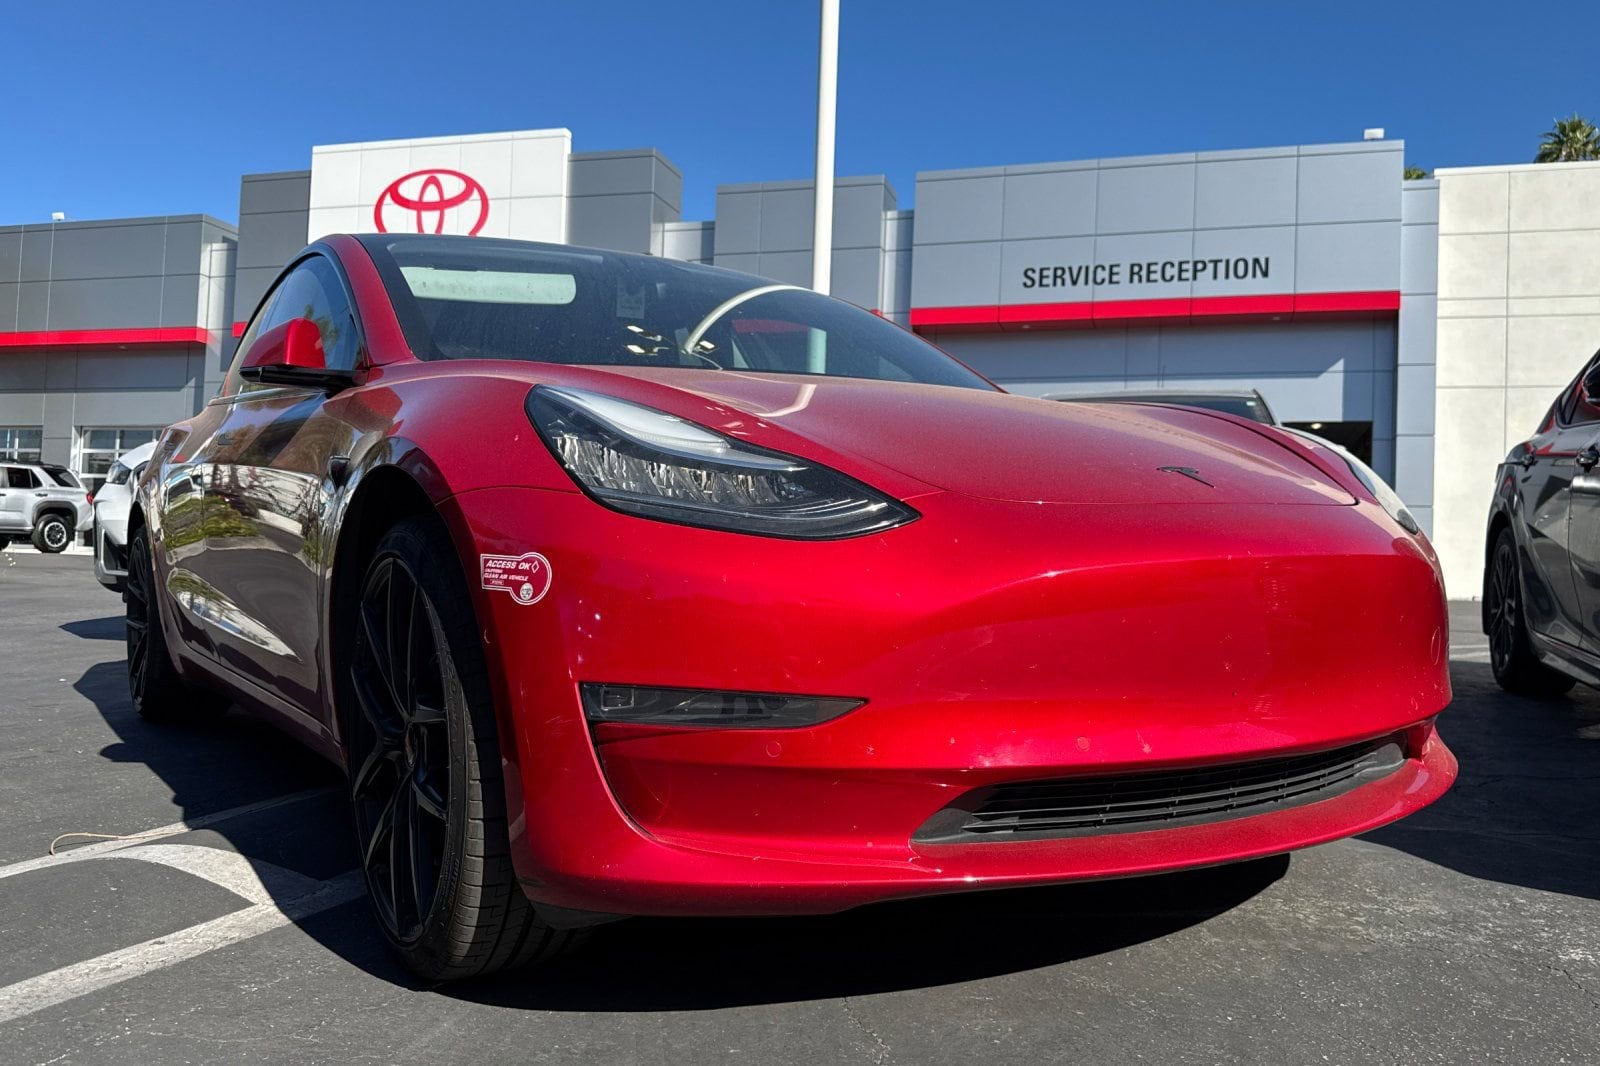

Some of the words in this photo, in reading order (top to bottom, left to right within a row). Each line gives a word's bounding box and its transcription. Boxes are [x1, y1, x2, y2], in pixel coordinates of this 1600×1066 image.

[1022, 263, 1120, 288] SERVICE
[1128, 257, 1270, 283] RECEPTION
[486, 560, 517, 569] ACCESS
[518, 562, 532, 570] OK
